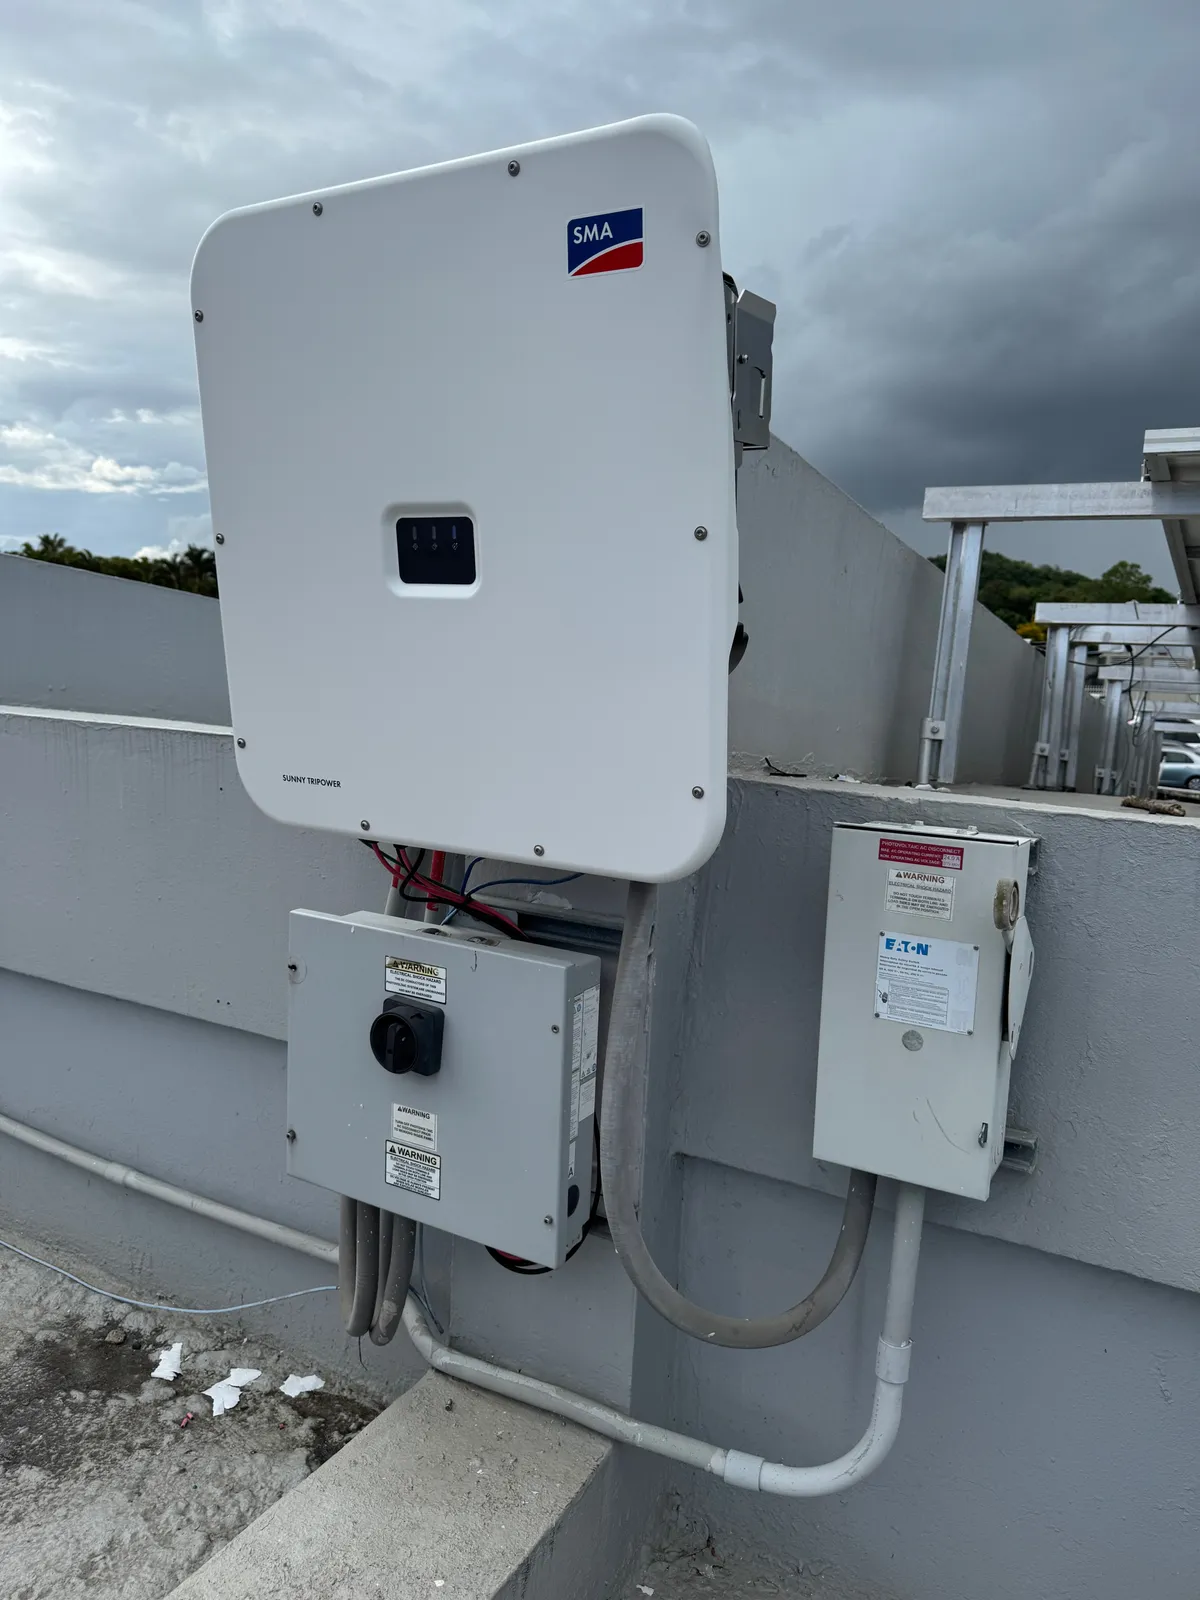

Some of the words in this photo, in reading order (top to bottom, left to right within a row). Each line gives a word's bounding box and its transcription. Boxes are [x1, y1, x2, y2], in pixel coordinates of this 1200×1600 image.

[573, 222, 613, 244] SMA
[282, 774, 306, 784] SUNNY
[307, 778, 342, 788] TRIPOWER
[882, 841, 919, 850] PHOTOVOLTAIC
[902, 872, 945, 884] WARNING
[400, 961, 439, 976] WARNING
[402, 1106, 430, 1120] WARNING
[398, 1146, 437, 1166] WARNING
